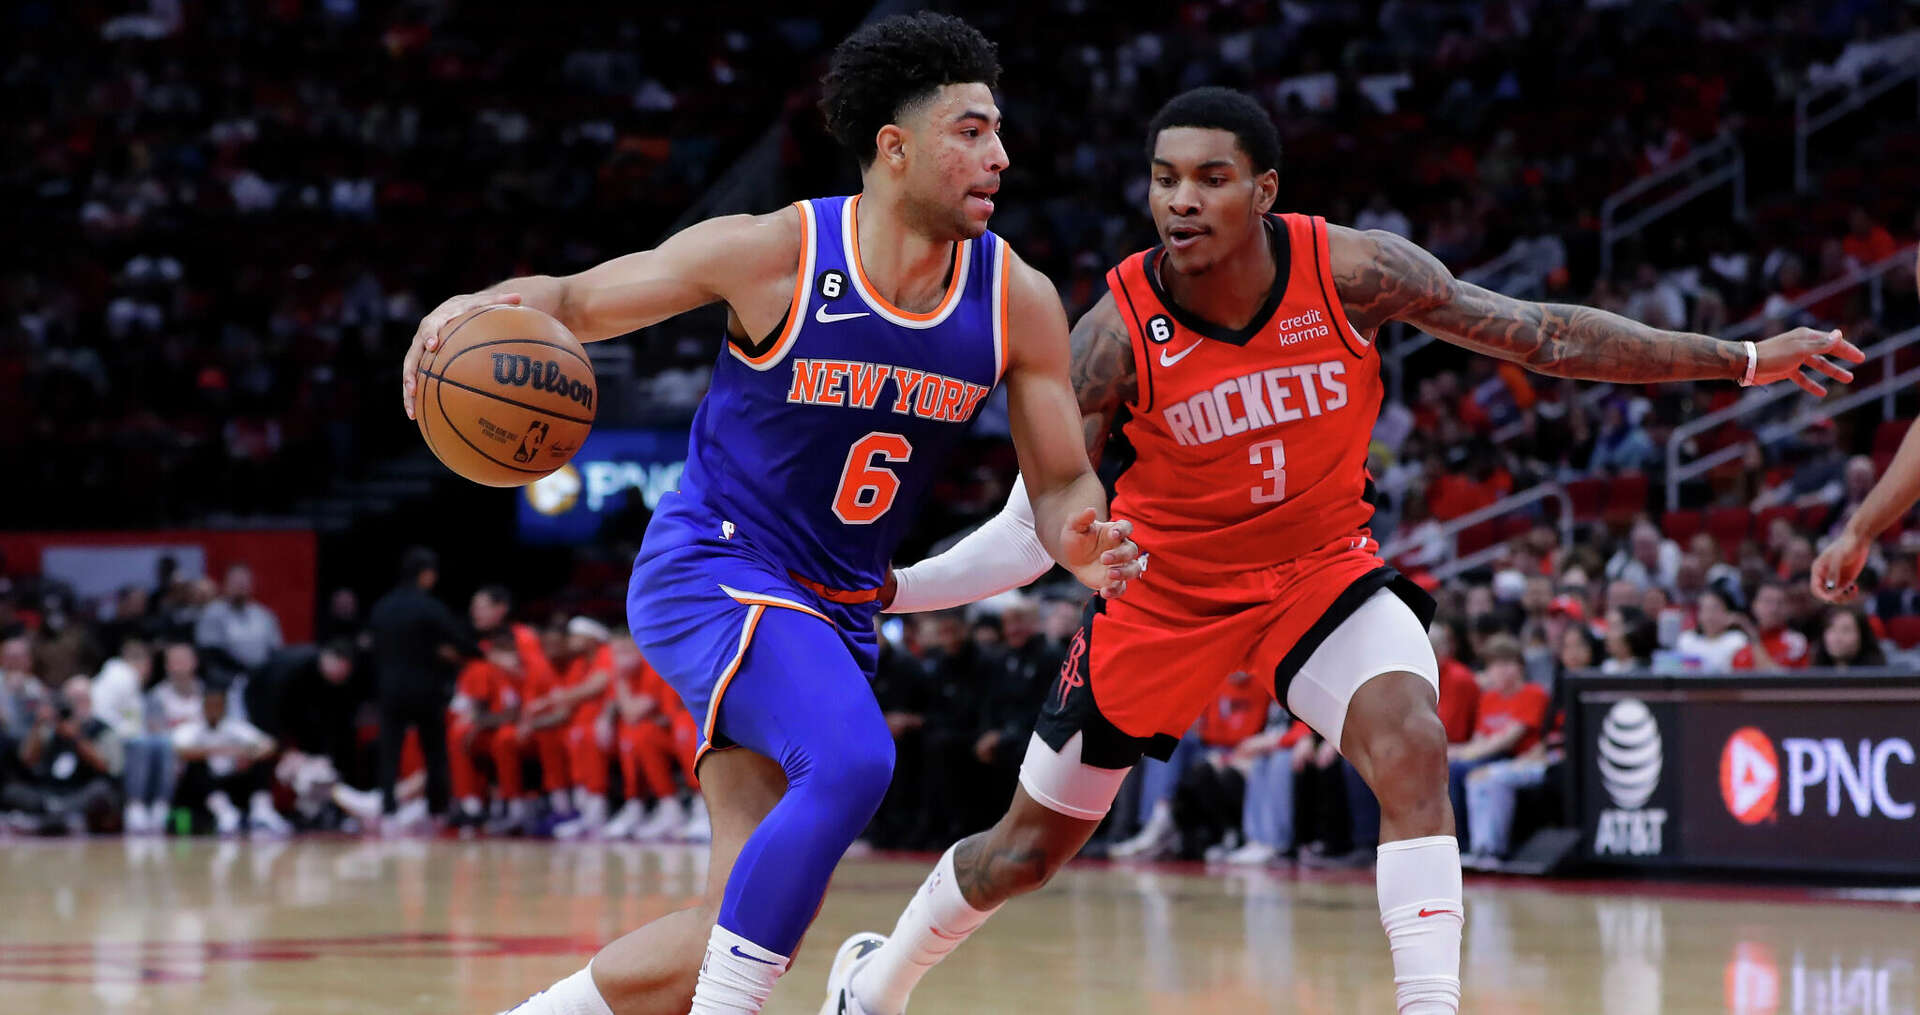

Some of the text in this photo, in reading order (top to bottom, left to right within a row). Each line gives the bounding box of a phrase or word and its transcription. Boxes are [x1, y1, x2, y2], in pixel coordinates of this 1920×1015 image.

[822, 272, 842, 297] 6
[1150, 317, 1171, 342] 6
[1279, 309, 1323, 331] credit
[1279, 325, 1329, 347] karma
[491, 352, 593, 411] Wilson
[786, 358, 992, 423] NEW YORK
[1163, 360, 1348, 446] ROCKETS
[831, 431, 913, 525] 6
[1249, 439, 1286, 504] 3
[1783, 737, 1916, 820] PNC
[1594, 808, 1668, 856] AT&T
